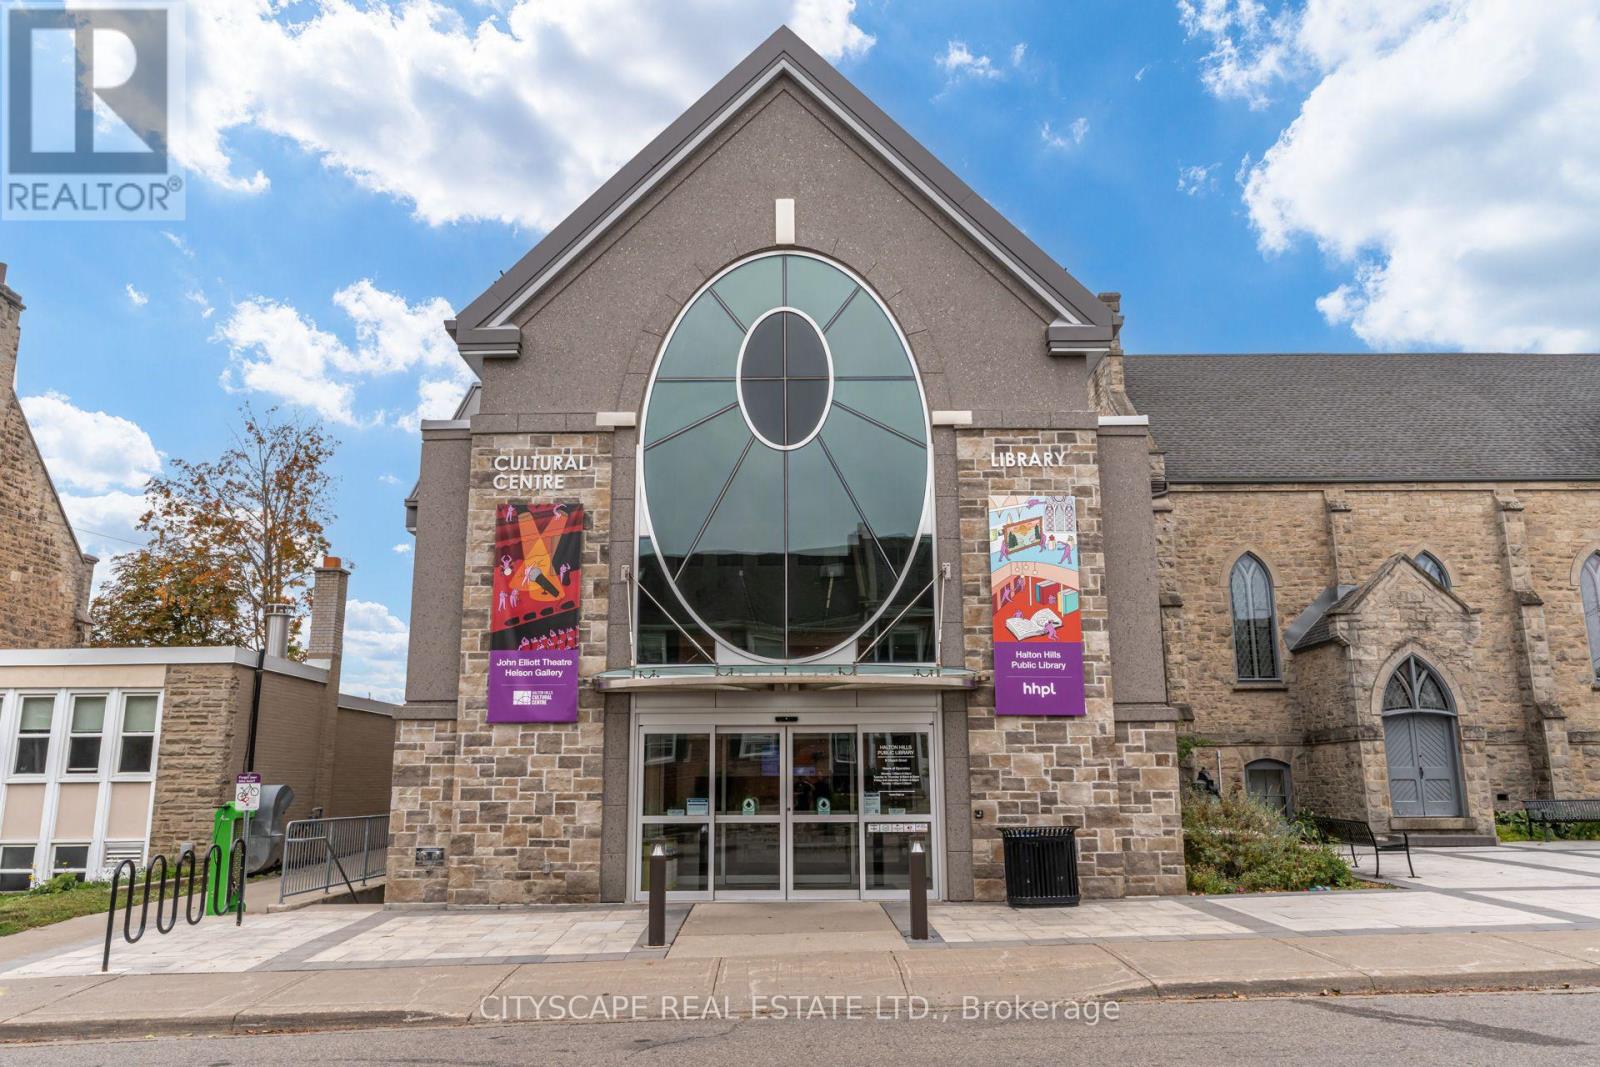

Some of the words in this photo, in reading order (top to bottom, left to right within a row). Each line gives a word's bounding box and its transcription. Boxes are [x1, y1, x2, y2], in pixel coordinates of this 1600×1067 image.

[494, 455, 587, 471] CULTURAL
[991, 452, 1065, 467] LIBRARY
[493, 474, 564, 489] CENTRE
[1015, 651, 1041, 659] Halton
[1043, 651, 1061, 659] Hills
[1011, 661, 1037, 669] Public
[1038, 661, 1066, 670] Library
[505, 669, 533, 677] Helson
[534, 669, 563, 678] Gallery
[1023, 682, 1056, 698] hhpl
